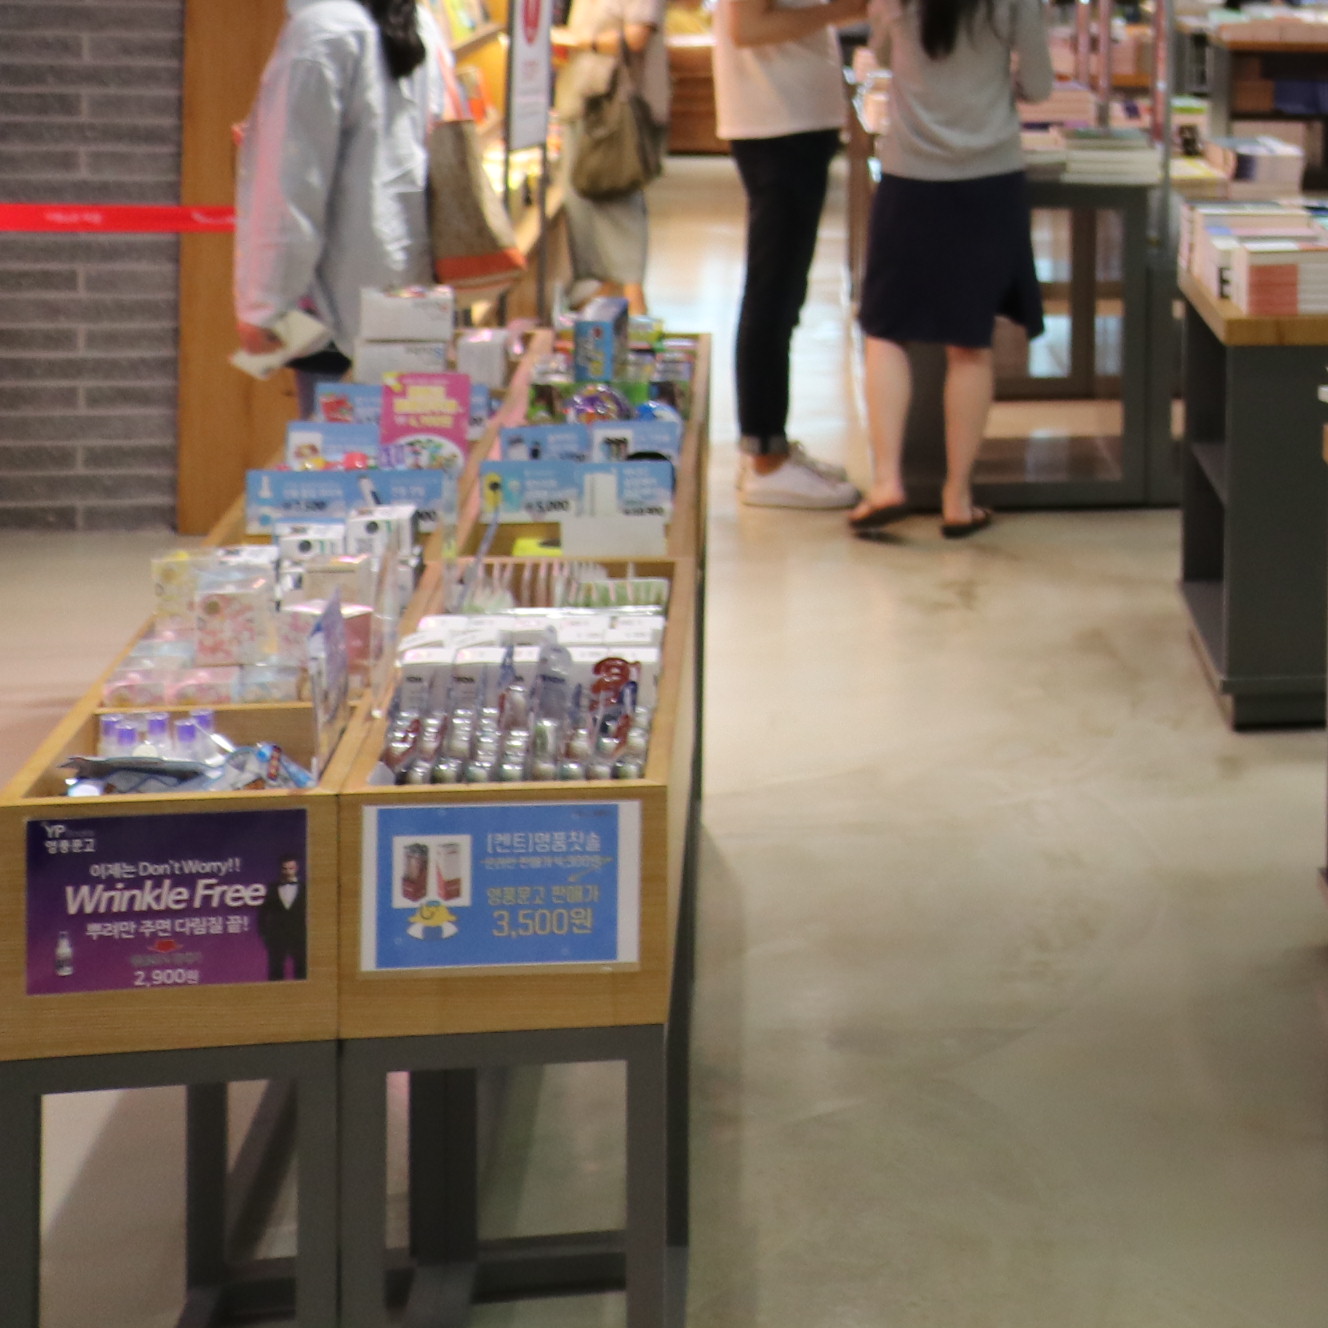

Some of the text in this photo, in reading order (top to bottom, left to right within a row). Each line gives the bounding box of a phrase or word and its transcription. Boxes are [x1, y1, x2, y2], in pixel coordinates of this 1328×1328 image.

[89, 862, 138, 880] 이제는
[65, 878, 267, 915] Wrinkle Free
[139, 919, 173, 937] 주면
[492, 907, 593, 939] 3,500원
[133, 968, 201, 988] 2,900원
